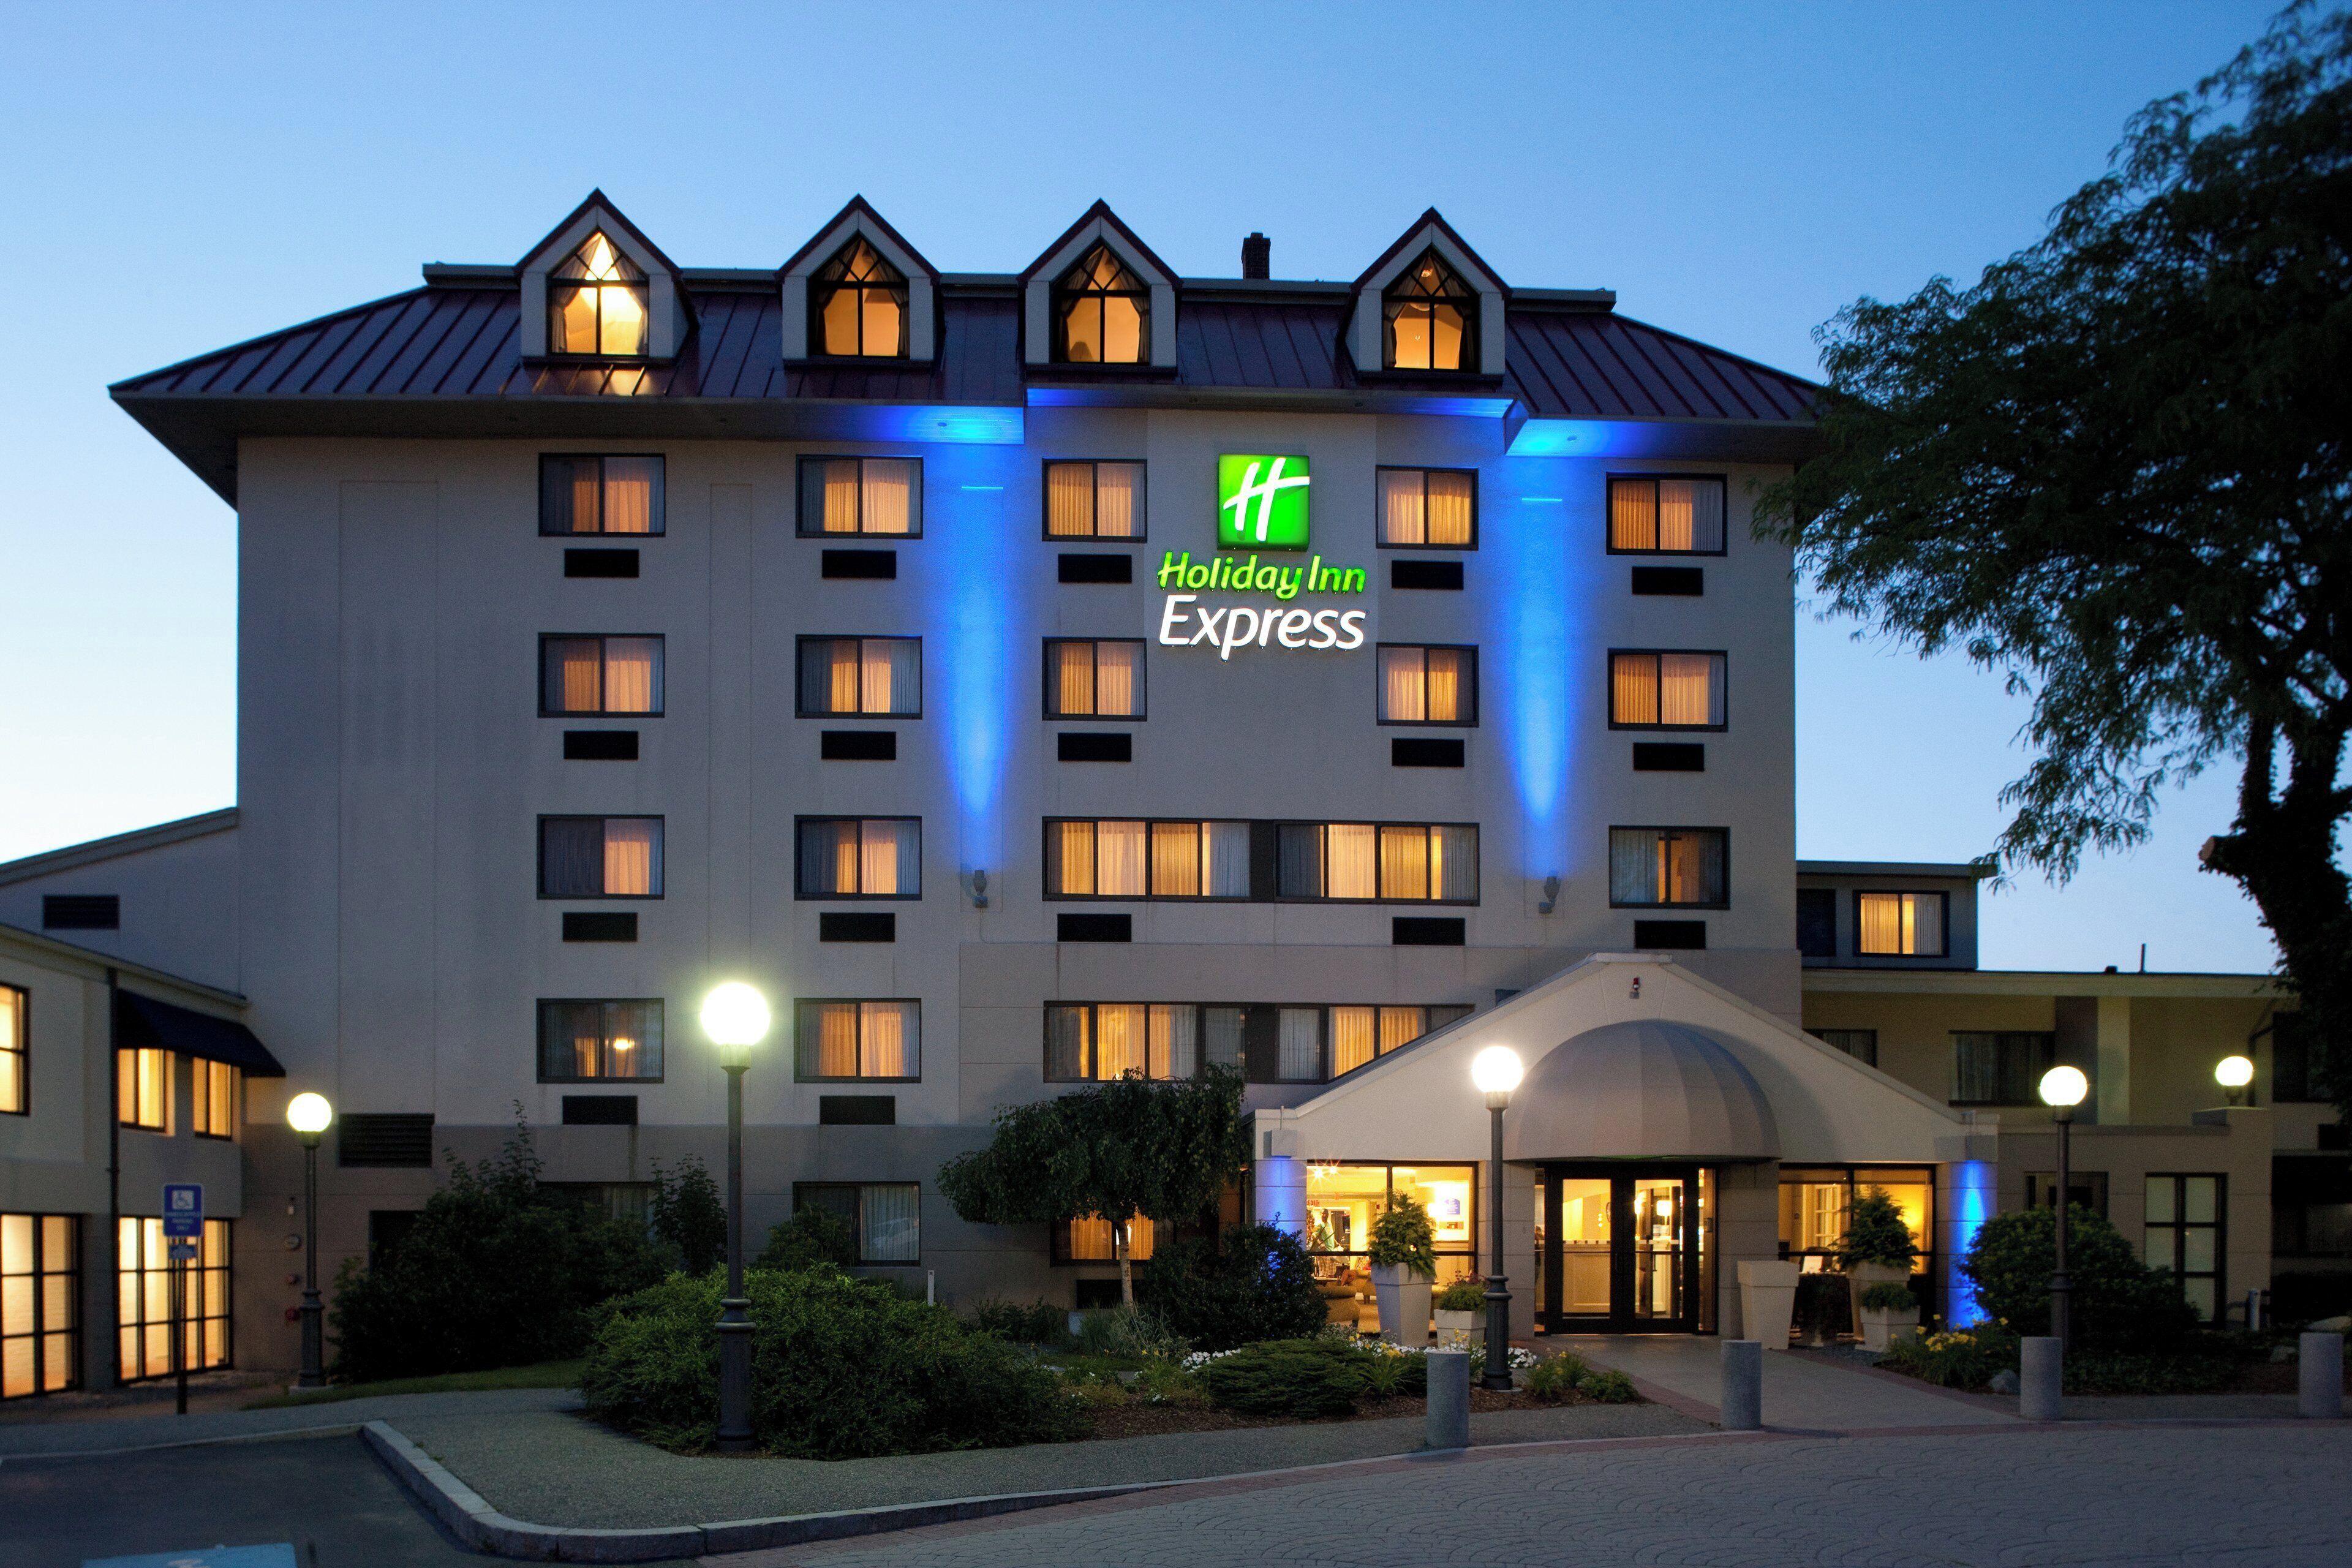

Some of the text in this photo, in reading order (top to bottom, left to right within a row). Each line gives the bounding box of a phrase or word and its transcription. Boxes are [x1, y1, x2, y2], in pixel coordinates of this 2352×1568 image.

[1224, 458, 1310, 541] H
[1158, 552, 1366, 600] Holiday Inn
[1159, 595, 1366, 660] Express
